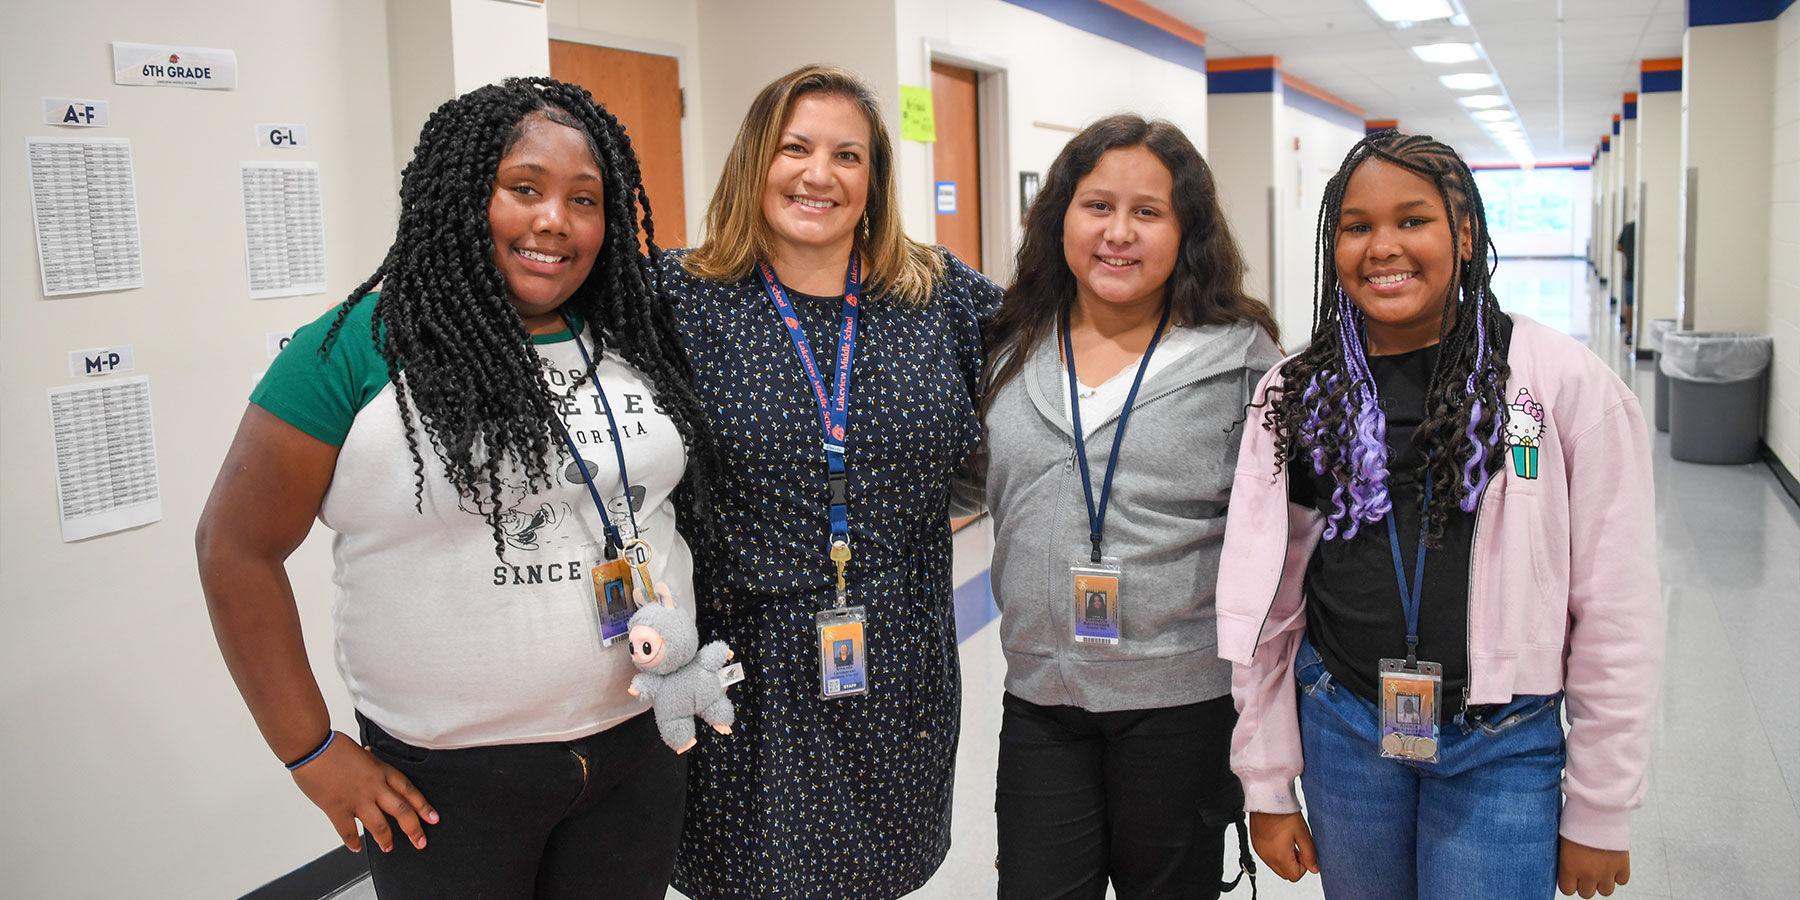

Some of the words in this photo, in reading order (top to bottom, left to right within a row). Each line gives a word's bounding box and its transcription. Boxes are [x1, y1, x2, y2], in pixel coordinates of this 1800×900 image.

[142, 65, 164, 77] 6TH
[167, 66, 211, 79] GRADE
[63, 104, 95, 124] A-F
[269, 129, 297, 146] G-L
[770, 284, 788, 308] School
[843, 316, 854, 341] School
[85, 352, 121, 374] M-P
[840, 342, 851, 370] Middle
[549, 369, 583, 386] OS
[797, 340, 817, 378] Lakeview
[813, 380, 827, 409] Middle
[823, 411, 832, 437] Scho
[836, 371, 847, 412] Lakeview
[493, 561, 582, 586] SINCE
